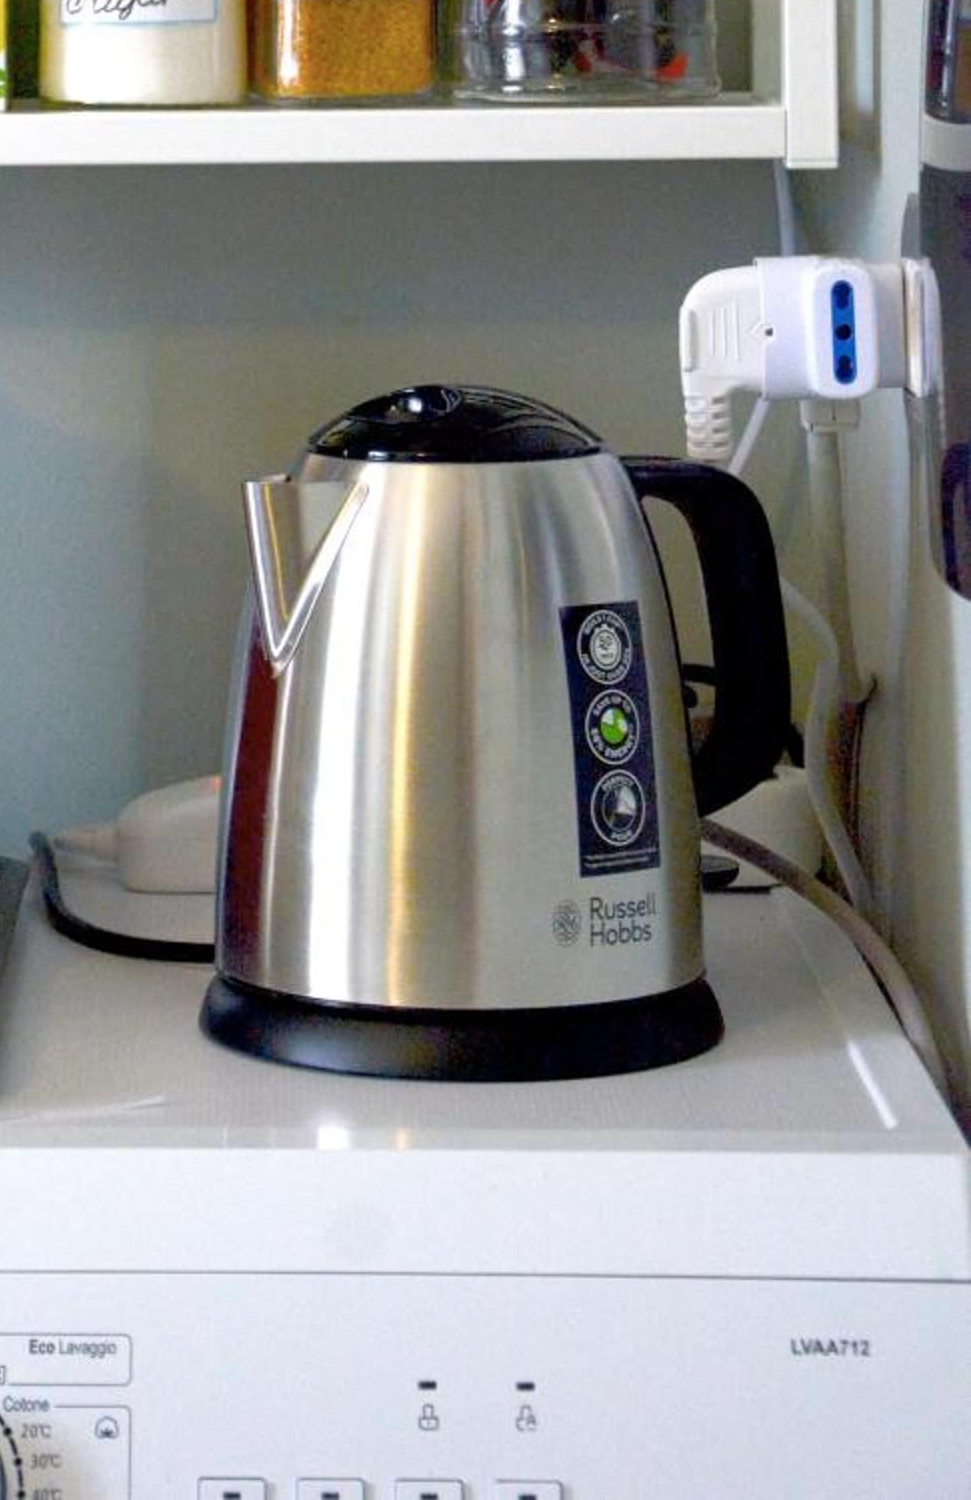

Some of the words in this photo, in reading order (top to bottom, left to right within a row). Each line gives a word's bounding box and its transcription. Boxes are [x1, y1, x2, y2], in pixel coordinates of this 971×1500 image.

[589, 892, 656, 921] Russell
[590, 920, 652, 948] Hobbs
[28, 1339, 55, 1355] Eco
[58, 1340, 117, 1358] Lavaggio
[790, 1337, 870, 1356] LVAA712
[3, 1396, 50, 1412] Cotone
